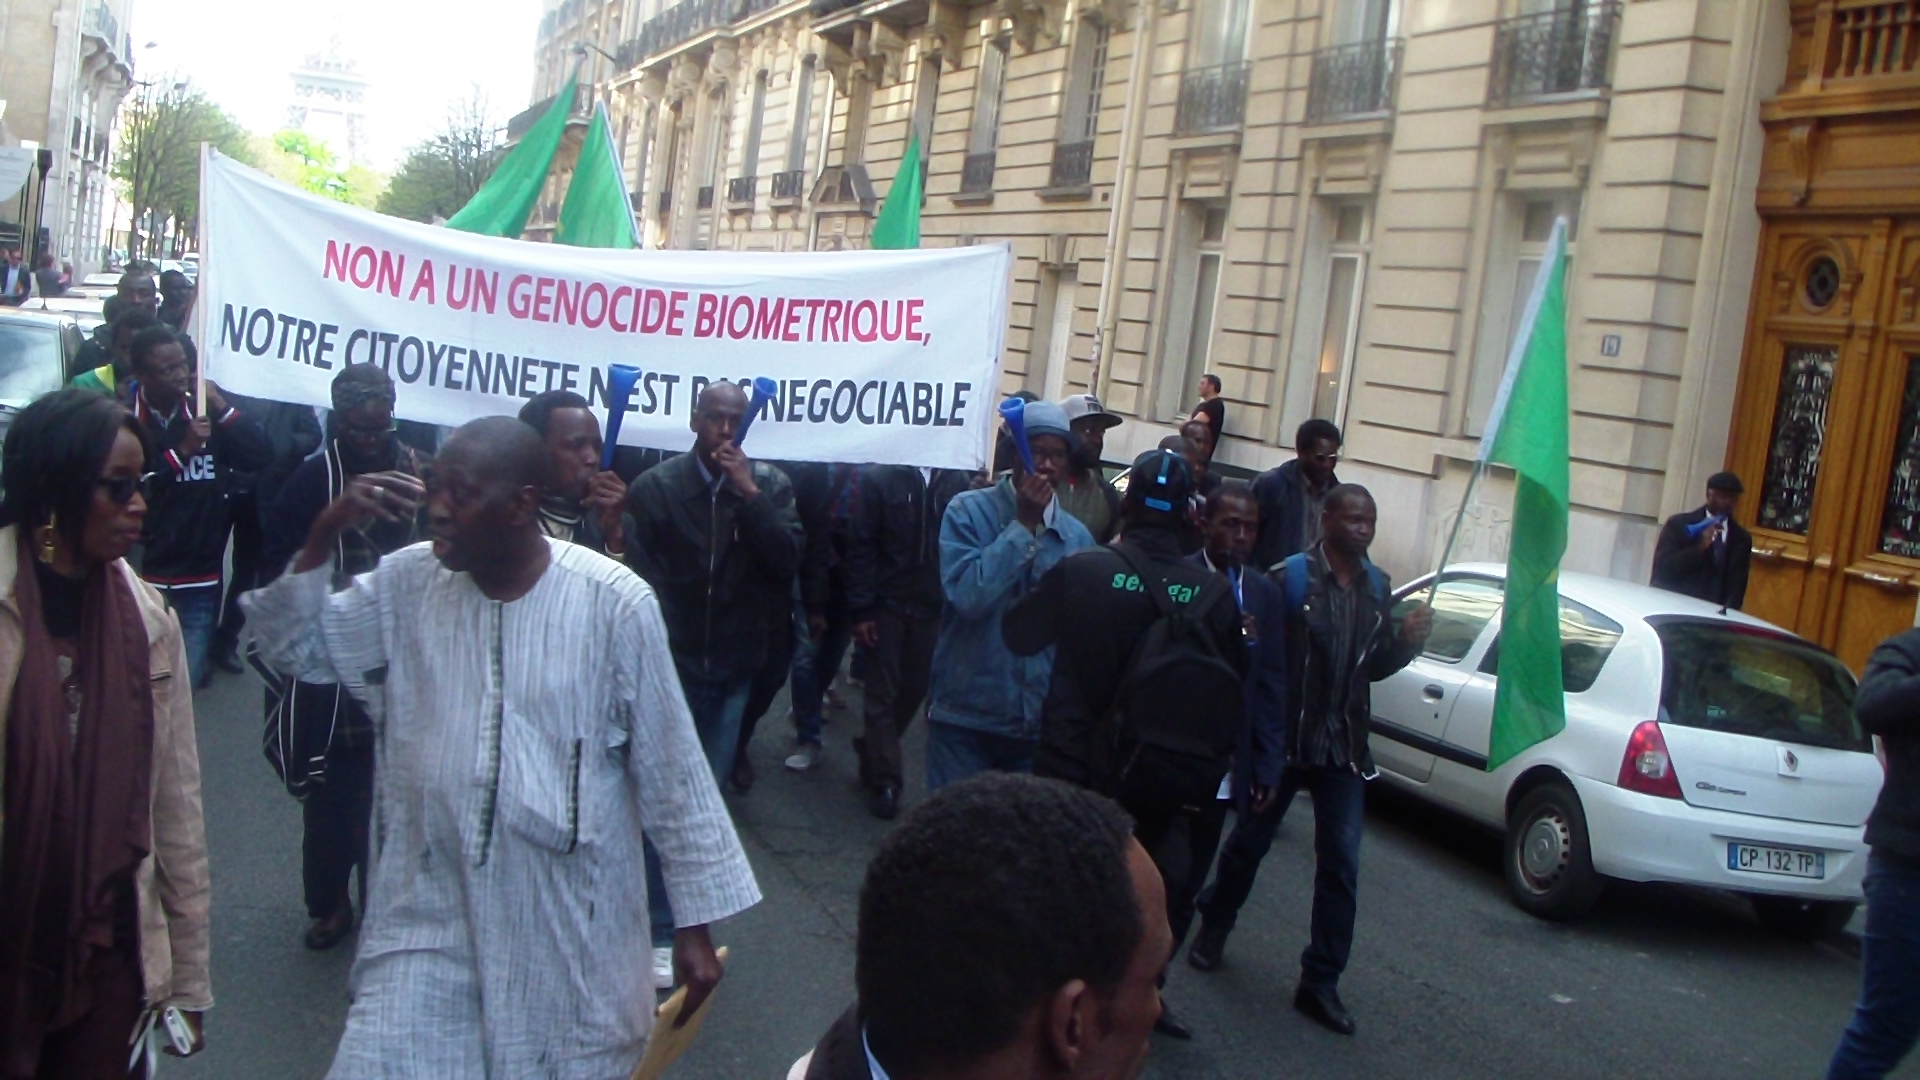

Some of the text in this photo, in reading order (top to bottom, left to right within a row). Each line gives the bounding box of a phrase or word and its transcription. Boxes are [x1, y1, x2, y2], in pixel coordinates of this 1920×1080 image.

[323, 240, 931, 345] NON A UN GENOCIDE BIOMETRIQUE,
[221, 303, 338, 369] NOTRE
[345, 328, 579, 400] CITOYENNETE
[761, 379, 971, 427] NEGOCIABLE
[1740, 847, 1815, 874] CP 132 TP
